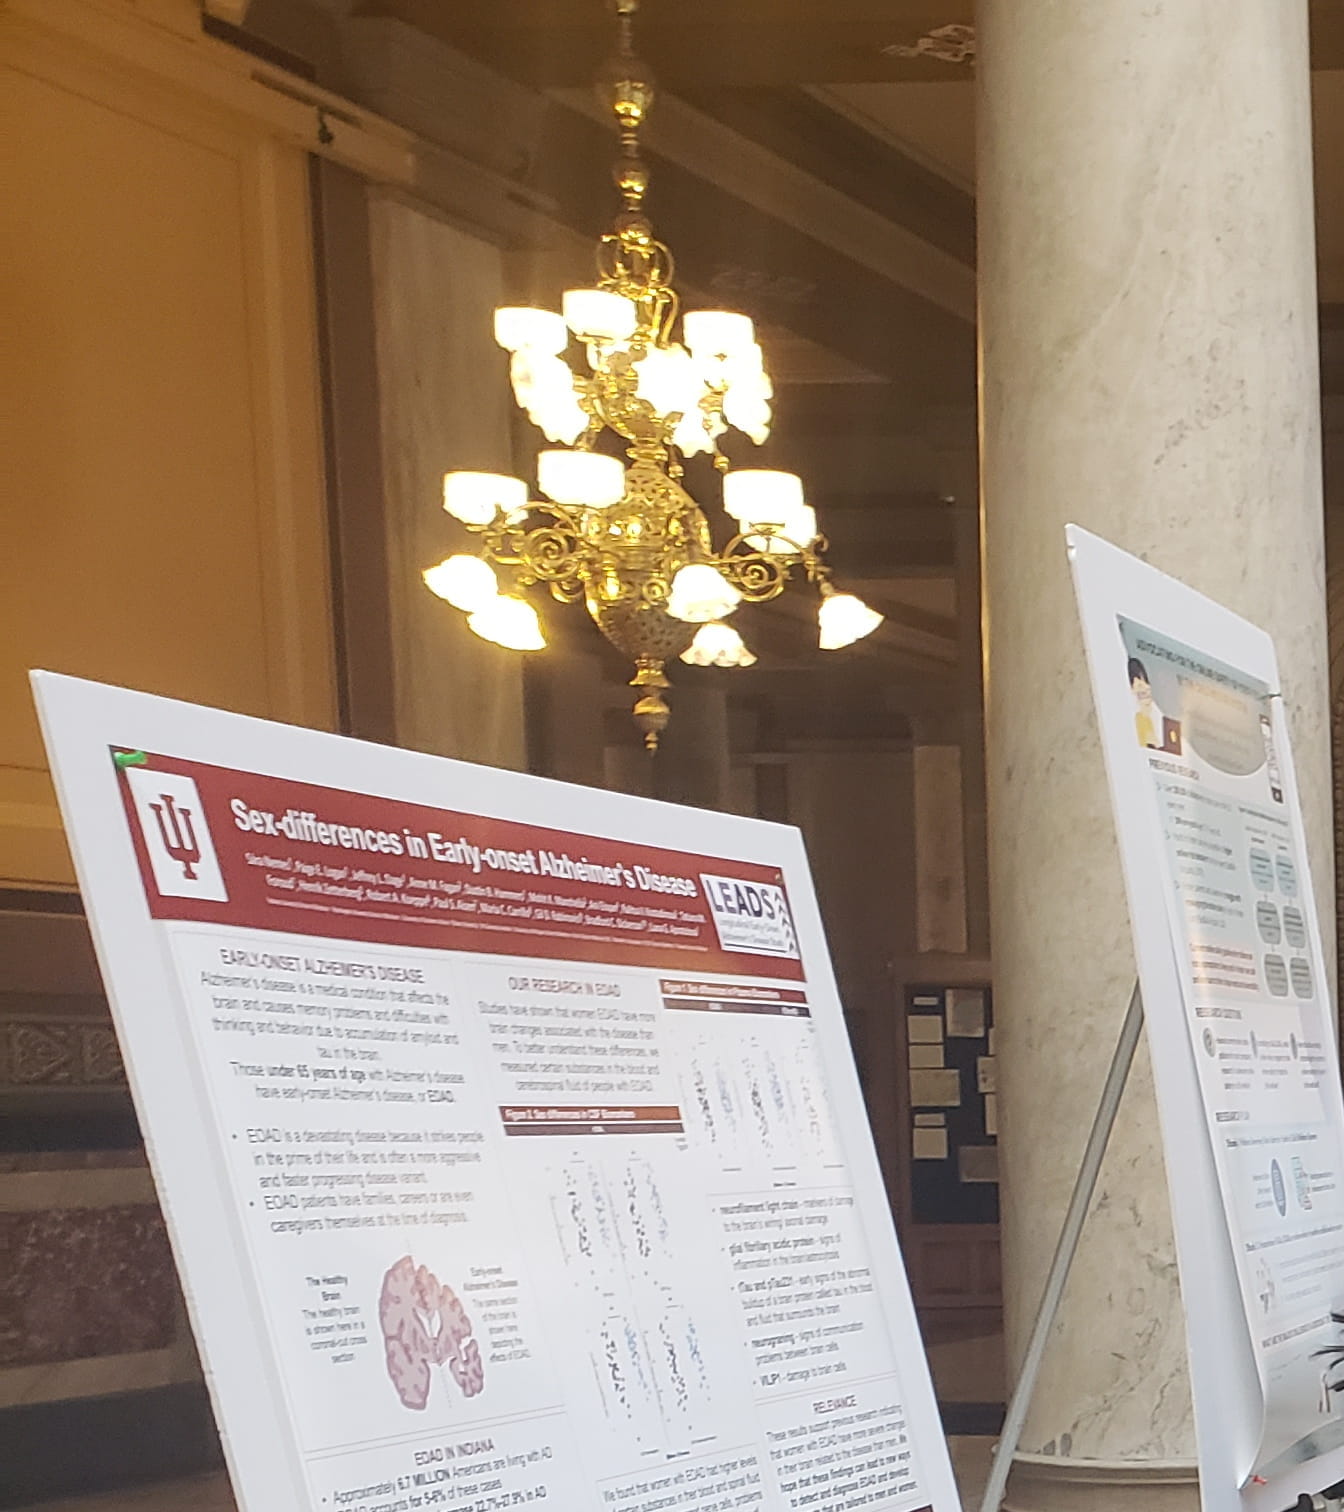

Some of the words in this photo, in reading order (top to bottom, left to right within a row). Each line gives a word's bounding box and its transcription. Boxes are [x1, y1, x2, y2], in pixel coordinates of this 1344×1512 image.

[231, 799, 403, 856] Sex-differences
[403, 829, 429, 859] in
[428, 833, 539, 874] Early-onset
[540, 850, 637, 890] Alzheimer's
[635, 865, 698, 898] Disease
[706, 878, 777, 919] LEADS
[377, 964, 425, 983] DISEASE
[413, 1448, 444, 1466] EOAD
[456, 1438, 494, 1457] INDIANA
